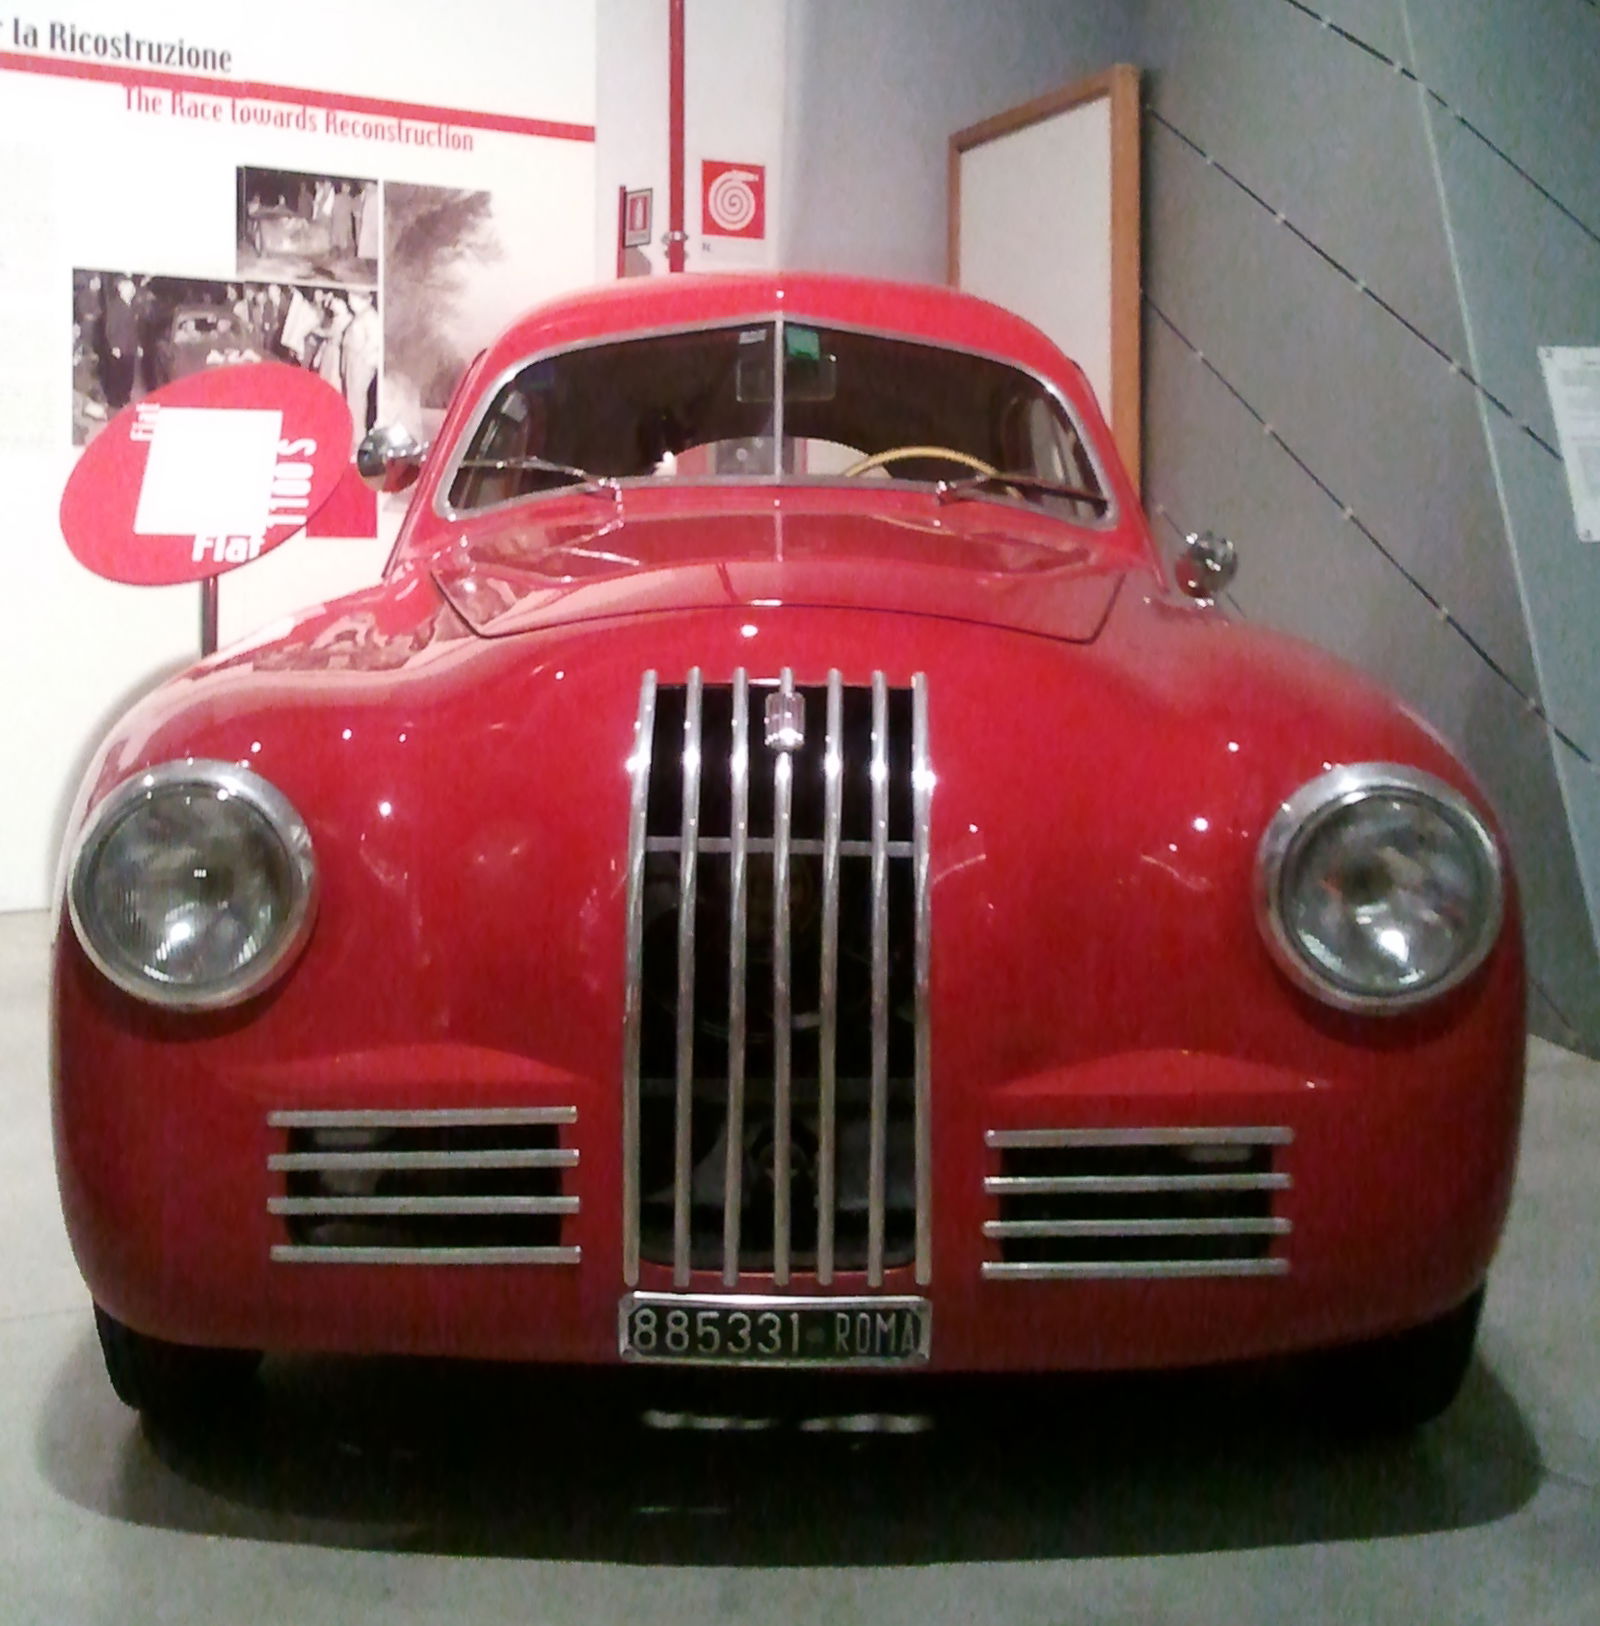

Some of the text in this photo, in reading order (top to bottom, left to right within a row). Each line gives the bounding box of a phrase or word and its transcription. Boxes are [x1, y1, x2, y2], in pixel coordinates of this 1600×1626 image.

[13, 17, 232, 73] la Ricostruzione
[122, 86, 162, 114] The
[171, 90, 223, 122] Race
[325, 109, 474, 152] Reconstruction
[633, 1308, 918, 1354] 885331 ROMA
